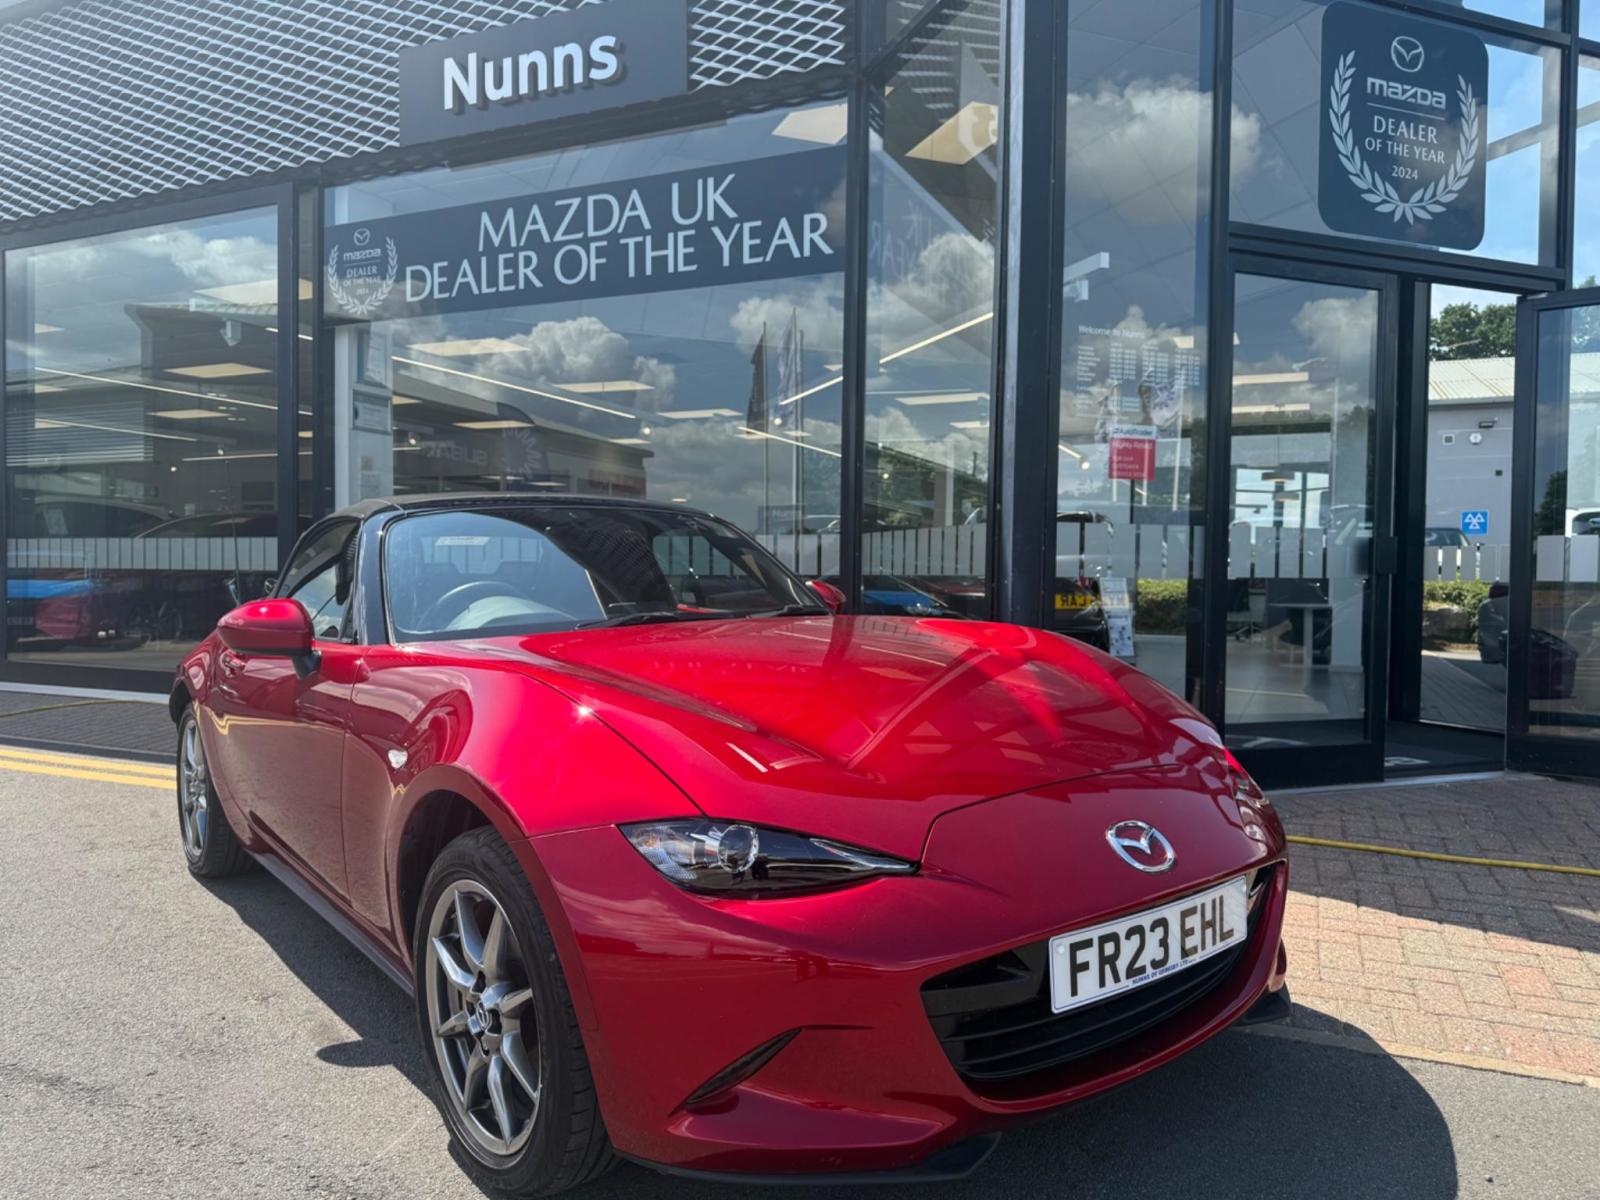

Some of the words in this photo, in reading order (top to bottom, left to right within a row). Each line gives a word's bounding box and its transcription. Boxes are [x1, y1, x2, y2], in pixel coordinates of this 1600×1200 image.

[443, 35, 619, 111] Nunns
[1373, 115, 1438, 144] DEALER
[1364, 137, 1383, 152] OF
[1387, 141, 1410, 158] THE
[1414, 146, 1446, 165] YEAR
[1391, 165, 1419, 180] 2024
[478, 189, 652, 252] MAZDA
[671, 173, 739, 226] UK
[346, 265, 378, 278] DEALER
[405, 250, 544, 302] DEALER
[553, 241, 608, 287] OF
[619, 228, 698, 278] THE
[710, 212, 836, 268] YEAR
[1078, 325, 1111, 336] Welcome
[1069, 916, 1170, 998] FR23
[1180, 895, 1235, 960] EHL
